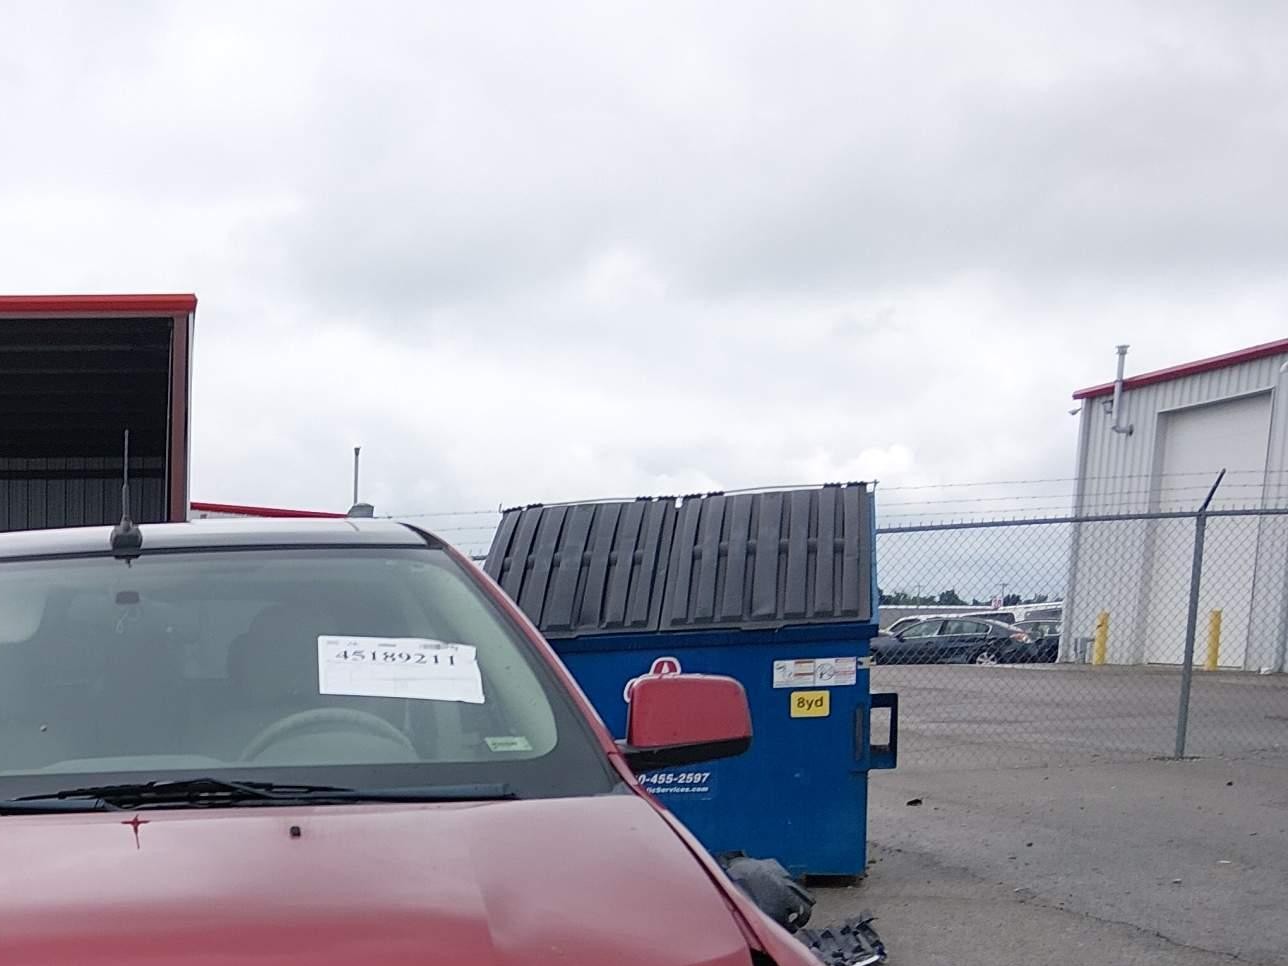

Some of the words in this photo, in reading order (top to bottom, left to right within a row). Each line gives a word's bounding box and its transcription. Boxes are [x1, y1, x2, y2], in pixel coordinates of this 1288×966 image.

[335, 650, 455, 665] 45189211
[796, 696, 824, 711] 8yd
[636, 772, 710, 785] 0-455-2597
